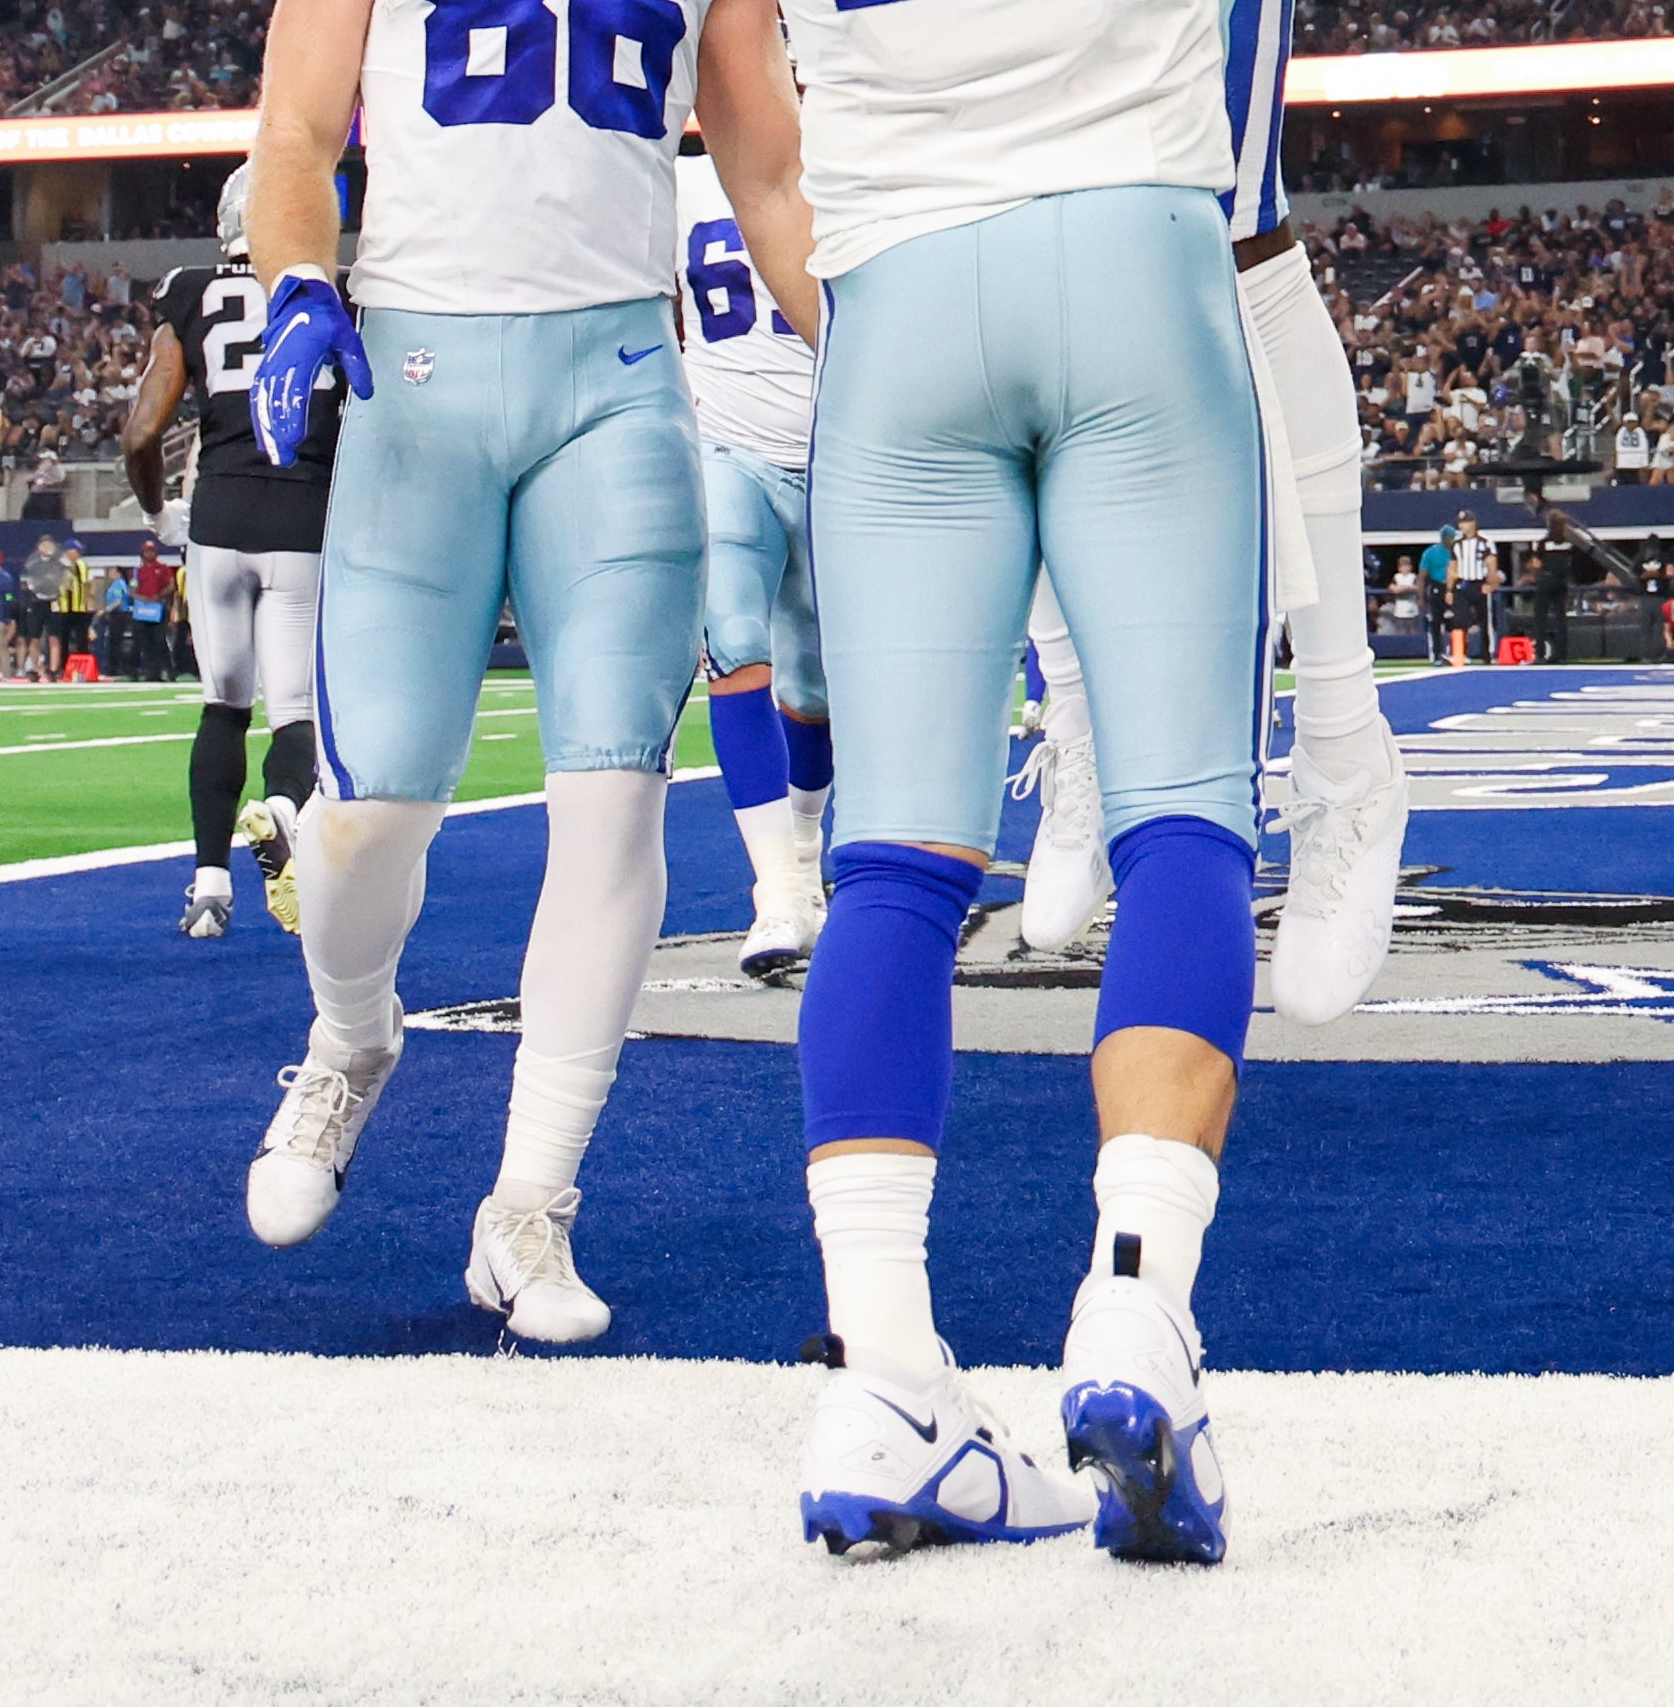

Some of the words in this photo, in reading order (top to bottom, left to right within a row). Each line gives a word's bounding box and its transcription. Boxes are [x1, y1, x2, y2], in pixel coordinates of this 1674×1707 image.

[26, 127, 70, 149] THE
[77, 124, 163, 147] DALLAS
[167, 119, 259, 143] COWBO
[202, 277, 286, 399] 2
